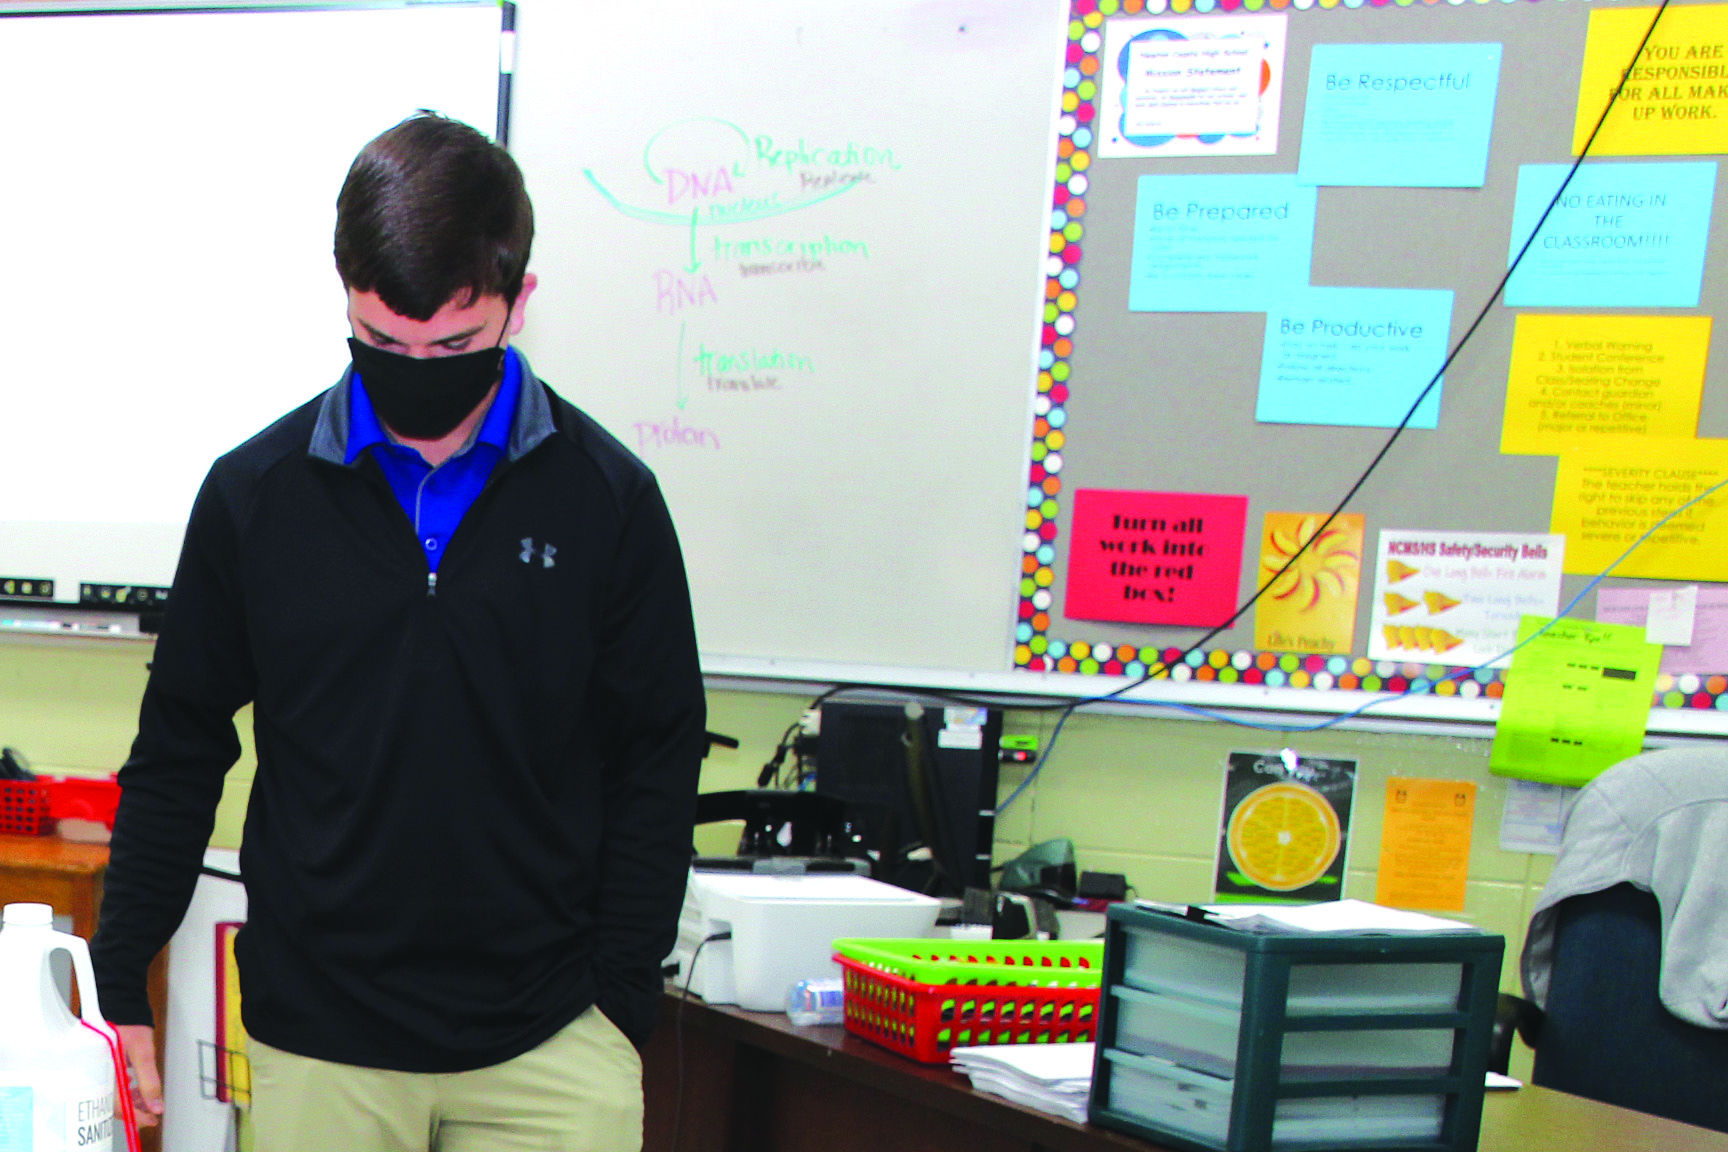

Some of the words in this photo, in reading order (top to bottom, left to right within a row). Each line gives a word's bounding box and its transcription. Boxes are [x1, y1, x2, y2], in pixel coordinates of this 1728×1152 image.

[1643, 45, 1681, 61] YOU
[1684, 44, 1725, 60] ARE
[1186, 66, 1242, 77] Statement
[1325, 74, 1351, 91] Be
[1358, 72, 1471, 94] Respectful
[1647, 86, 1683, 100] ALL
[1633, 106, 1657, 121] UP
[1661, 104, 1718, 120] WORK.
[753, 134, 904, 178] Replication
[662, 165, 736, 206] DNA
[1586, 194, 1644, 209] EATING
[1649, 194, 1667, 208] IN
[1153, 203, 1179, 221] Be
[1186, 202, 1289, 222] Prepared
[1594, 214, 1625, 229] THE
[651, 268, 720, 317] RNA
[1280, 318, 1305, 335] Be
[1311, 318, 1424, 339] Productive
[1100, 539, 1157, 555] work
[1111, 562, 1149, 577] the
[1154, 565, 1194, 580] red
